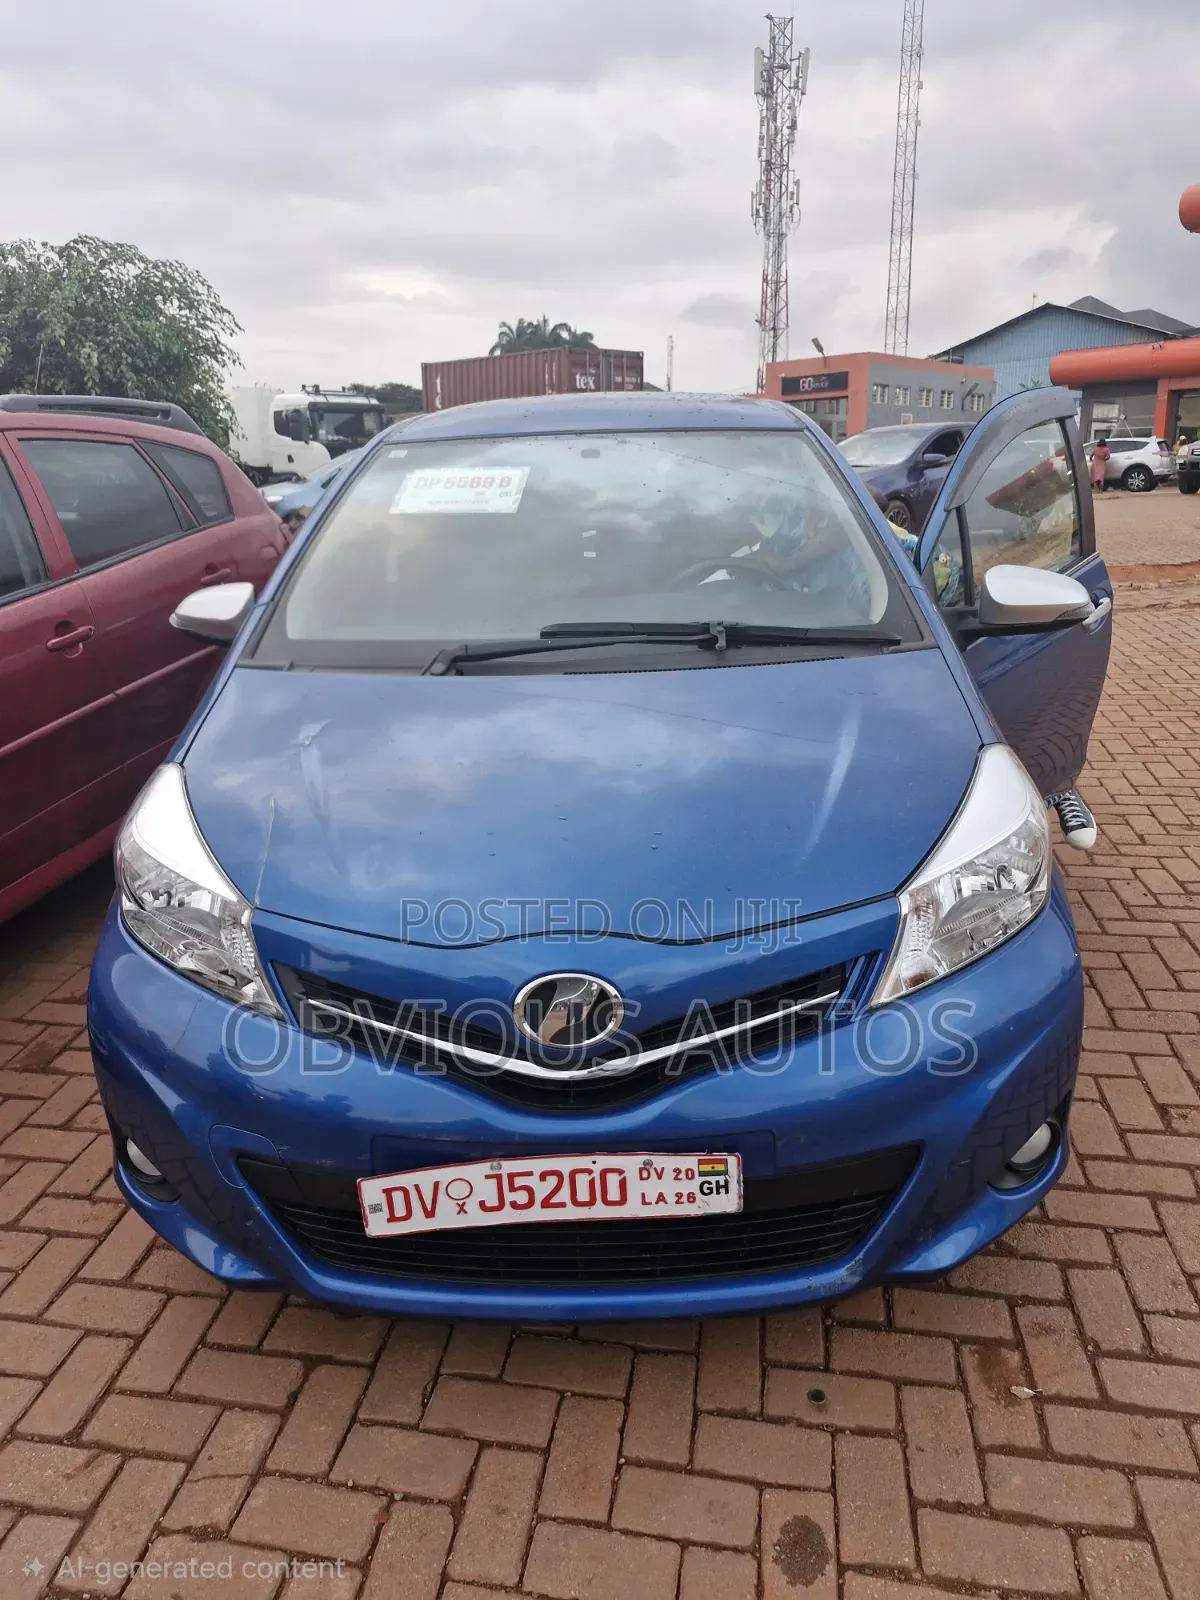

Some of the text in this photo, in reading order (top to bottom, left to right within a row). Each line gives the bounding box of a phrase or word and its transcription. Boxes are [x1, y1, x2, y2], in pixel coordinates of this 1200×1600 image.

[575, 372, 596, 390] tex
[639, 1167, 695, 1181] DV 20
[382, 1180, 440, 1223] DV
[478, 1167, 628, 1213] J5200
[699, 1179, 730, 1196] GH
[641, 1191, 697, 1206] LA 26
